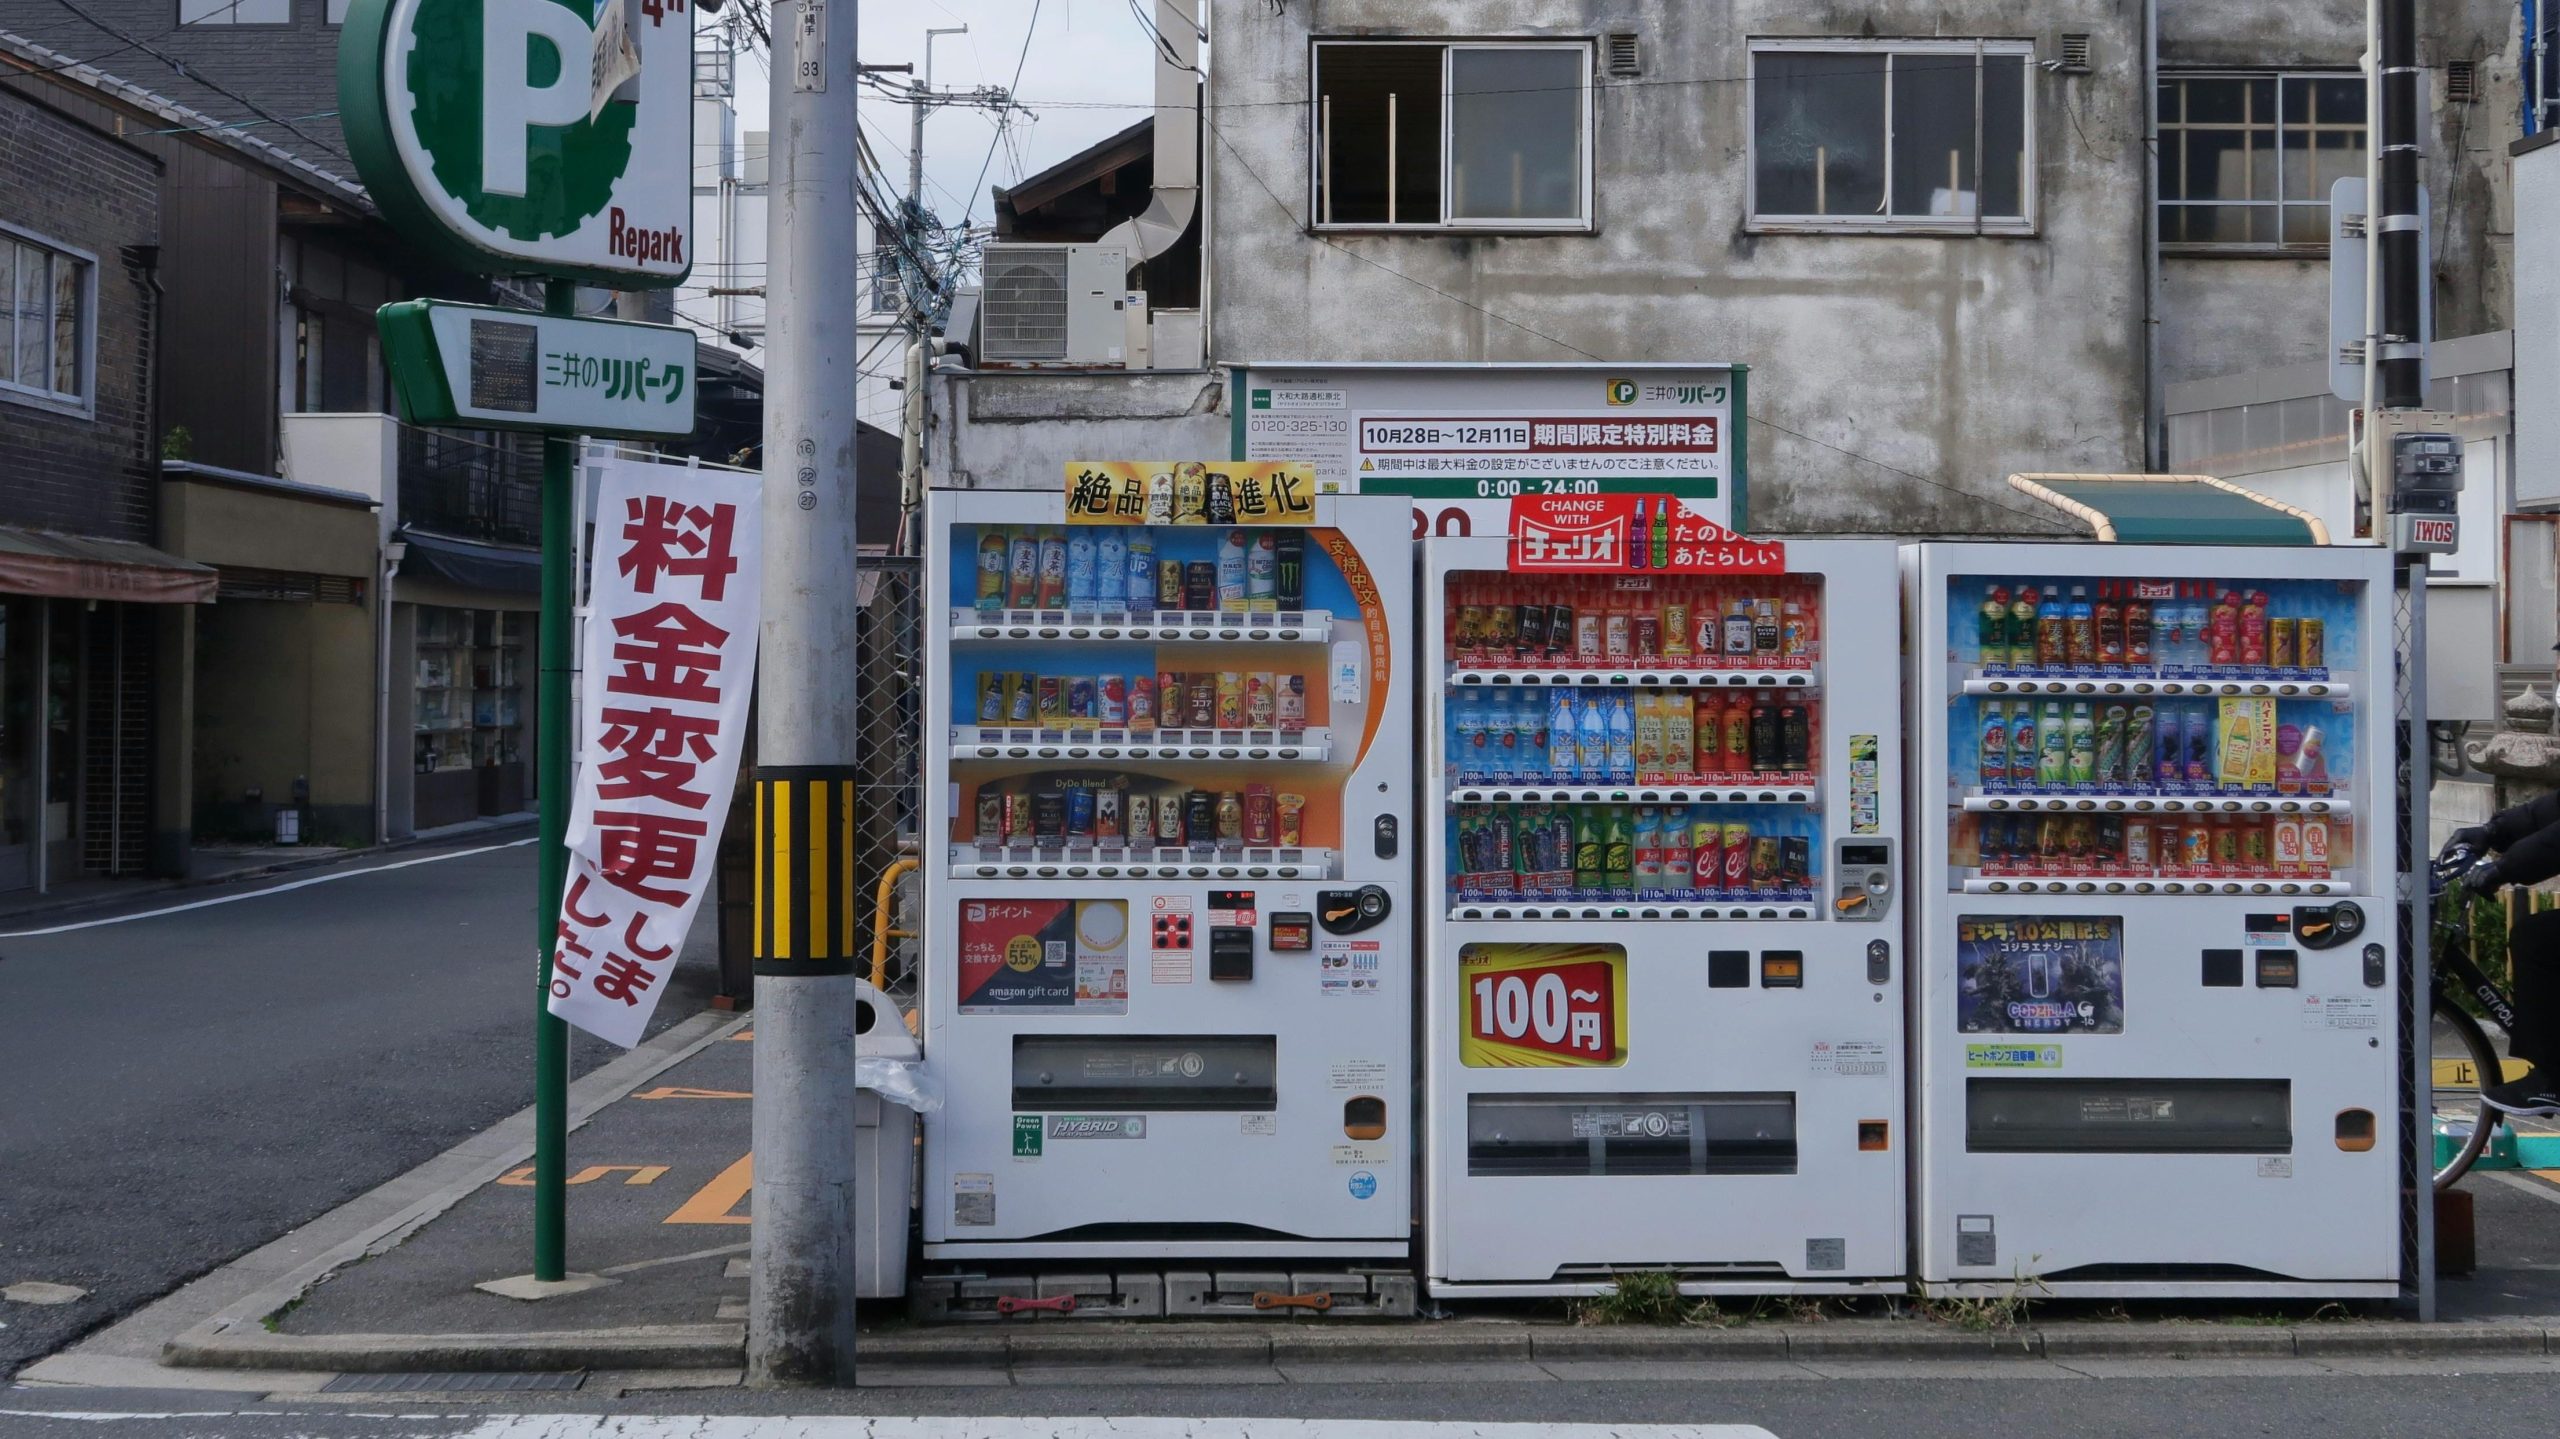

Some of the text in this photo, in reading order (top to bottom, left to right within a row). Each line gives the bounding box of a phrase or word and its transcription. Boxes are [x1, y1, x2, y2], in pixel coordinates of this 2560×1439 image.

[802, 61, 819, 77] 33
[609, 207, 683, 266] Repark
[545, 352, 684, 404] 三井のリパーク
[1645, 386, 1726, 404] 三井のリパーク
[1251, 420, 1347, 432] 0120-325-130
[1533, 423, 1714, 447] 期間限定特別料金
[1067, 469, 1145, 516] 絶品
[1235, 472, 1310, 516] 進化
[1542, 500, 1605, 513] CHANGE
[1554, 514, 1590, 525] WITH
[2415, 520, 2454, 543] IWOS
[1525, 531, 1616, 561] チェリオ
[1675, 547, 1778, 566] あたらしい
[593, 495, 738, 909] 料金変更
[1056, 779, 1106, 789] DyDo Blend
[989, 906, 1032, 918] ポイント
[964, 942, 995, 952] どっちと
[2000, 942, 2074, 952] ゴジラエナジー
[989, 986, 1069, 999] amazon gift card
[2477, 985, 2500, 1007] CITY
[2007, 1001, 2078, 1018] GODZILLA
[2014, 1019, 2071, 1028] ENERGY
[1968, 1050, 2036, 1062] ヒートポンプ自販機
[1054, 1121, 1119, 1136] HYBRID
